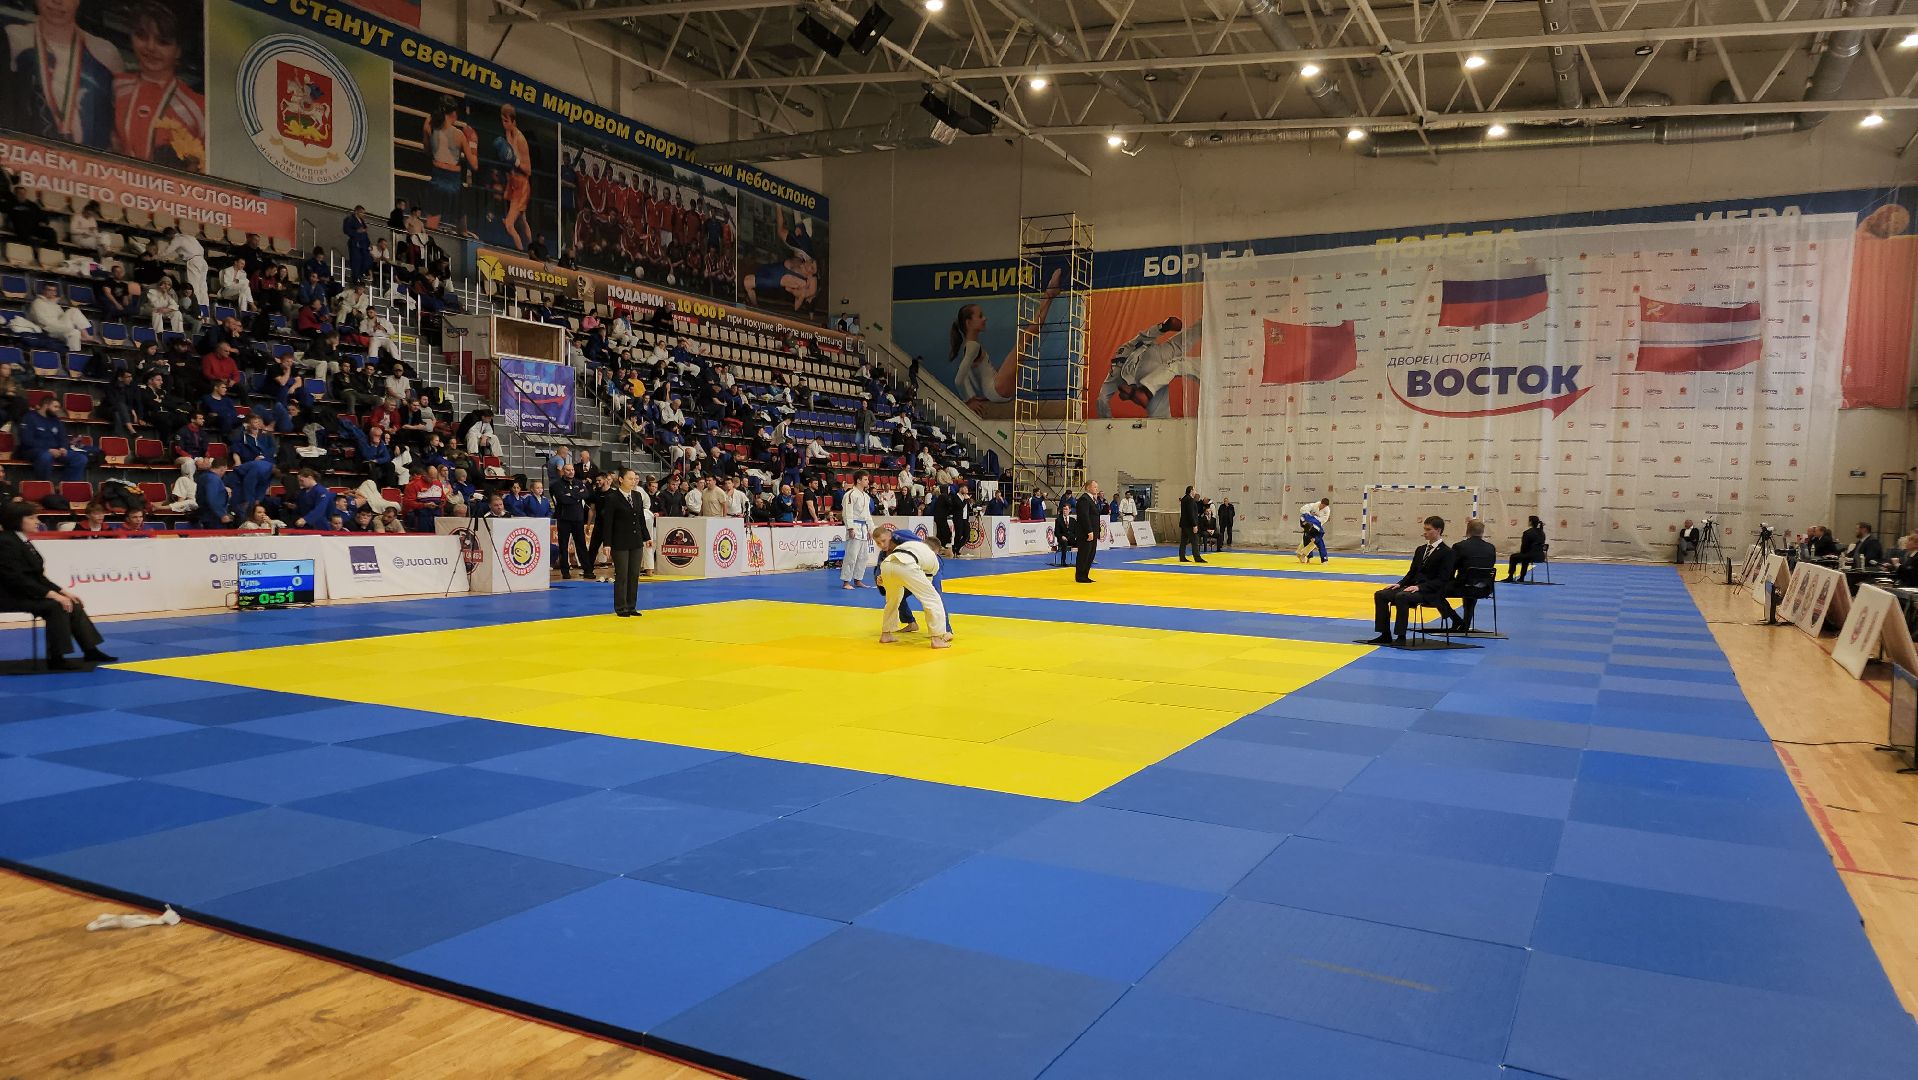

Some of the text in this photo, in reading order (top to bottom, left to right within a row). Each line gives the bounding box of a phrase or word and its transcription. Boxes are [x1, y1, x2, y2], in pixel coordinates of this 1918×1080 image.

[289, 0, 394, 47] станут
[400, 37, 503, 90] светить
[509, 79, 537, 104] на
[542, 91, 631, 140] мировом
[737, 168, 817, 210] небосклоне
[20, 170, 232, 228] ВАШЕГО ОБУЧЕНИЯ!
[83, 162, 175, 194] ЛУЧШИЕ
[180, 183, 268, 215] УСЛОВИЯ
[507, 265, 569, 288] KINGSTORE
[934, 265, 1034, 292] ГРАЦИЯ
[607, 284, 664, 308] ПОДАРКИ
[677, 298, 692, 313] 10
[694, 302, 717, 319] 000
[727, 314, 744, 327] при
[744, 317, 774, 332] покупке
[814, 332, 843, 349] Samsung
[1387, 352, 1492, 368] ДВОРЕЦ СПОРТА
[513, 379, 566, 397] ВОСТОК
[1407, 365, 1583, 397] ВОСТОК
[293, 565, 300, 574] 1
[405, 557, 448, 567] JUDO.RU
[291, 576, 302, 586] 0
[259, 592, 294, 604] 0:51
